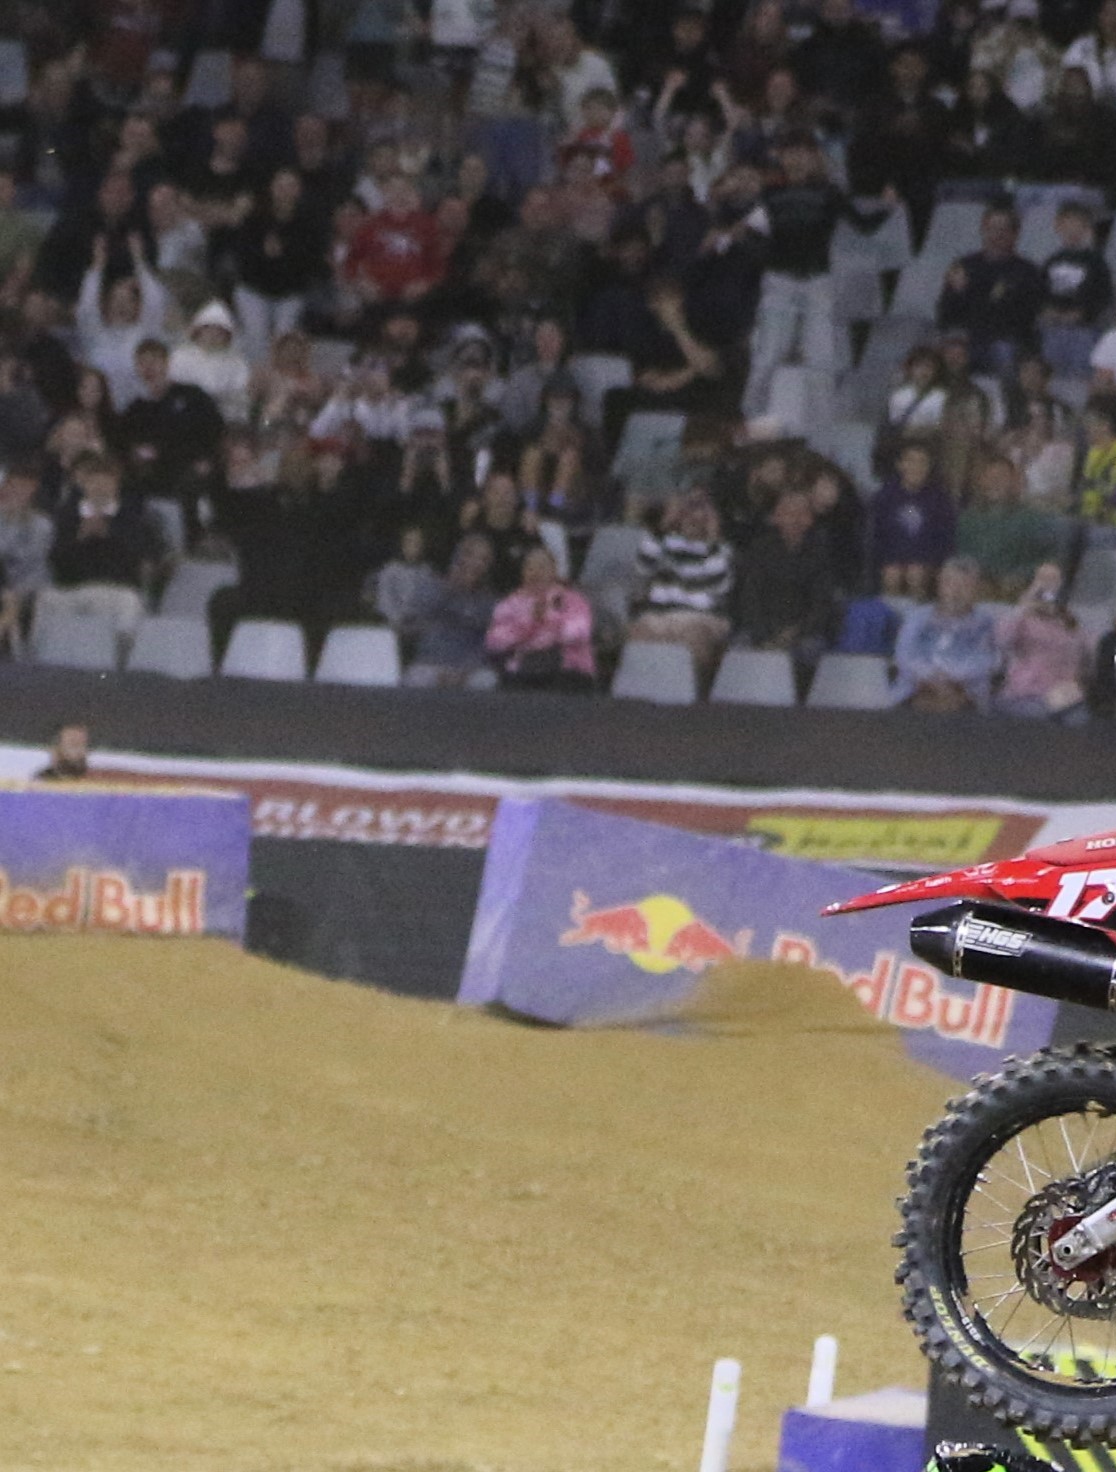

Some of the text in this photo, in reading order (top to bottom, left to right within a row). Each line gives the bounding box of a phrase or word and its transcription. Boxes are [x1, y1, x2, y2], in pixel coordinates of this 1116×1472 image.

[94, 869, 204, 933] Bull
[977, 926, 1028, 950] HGS
[895, 964, 1012, 1048] Bull
[929, 1285, 989, 1369] DUNLOP
